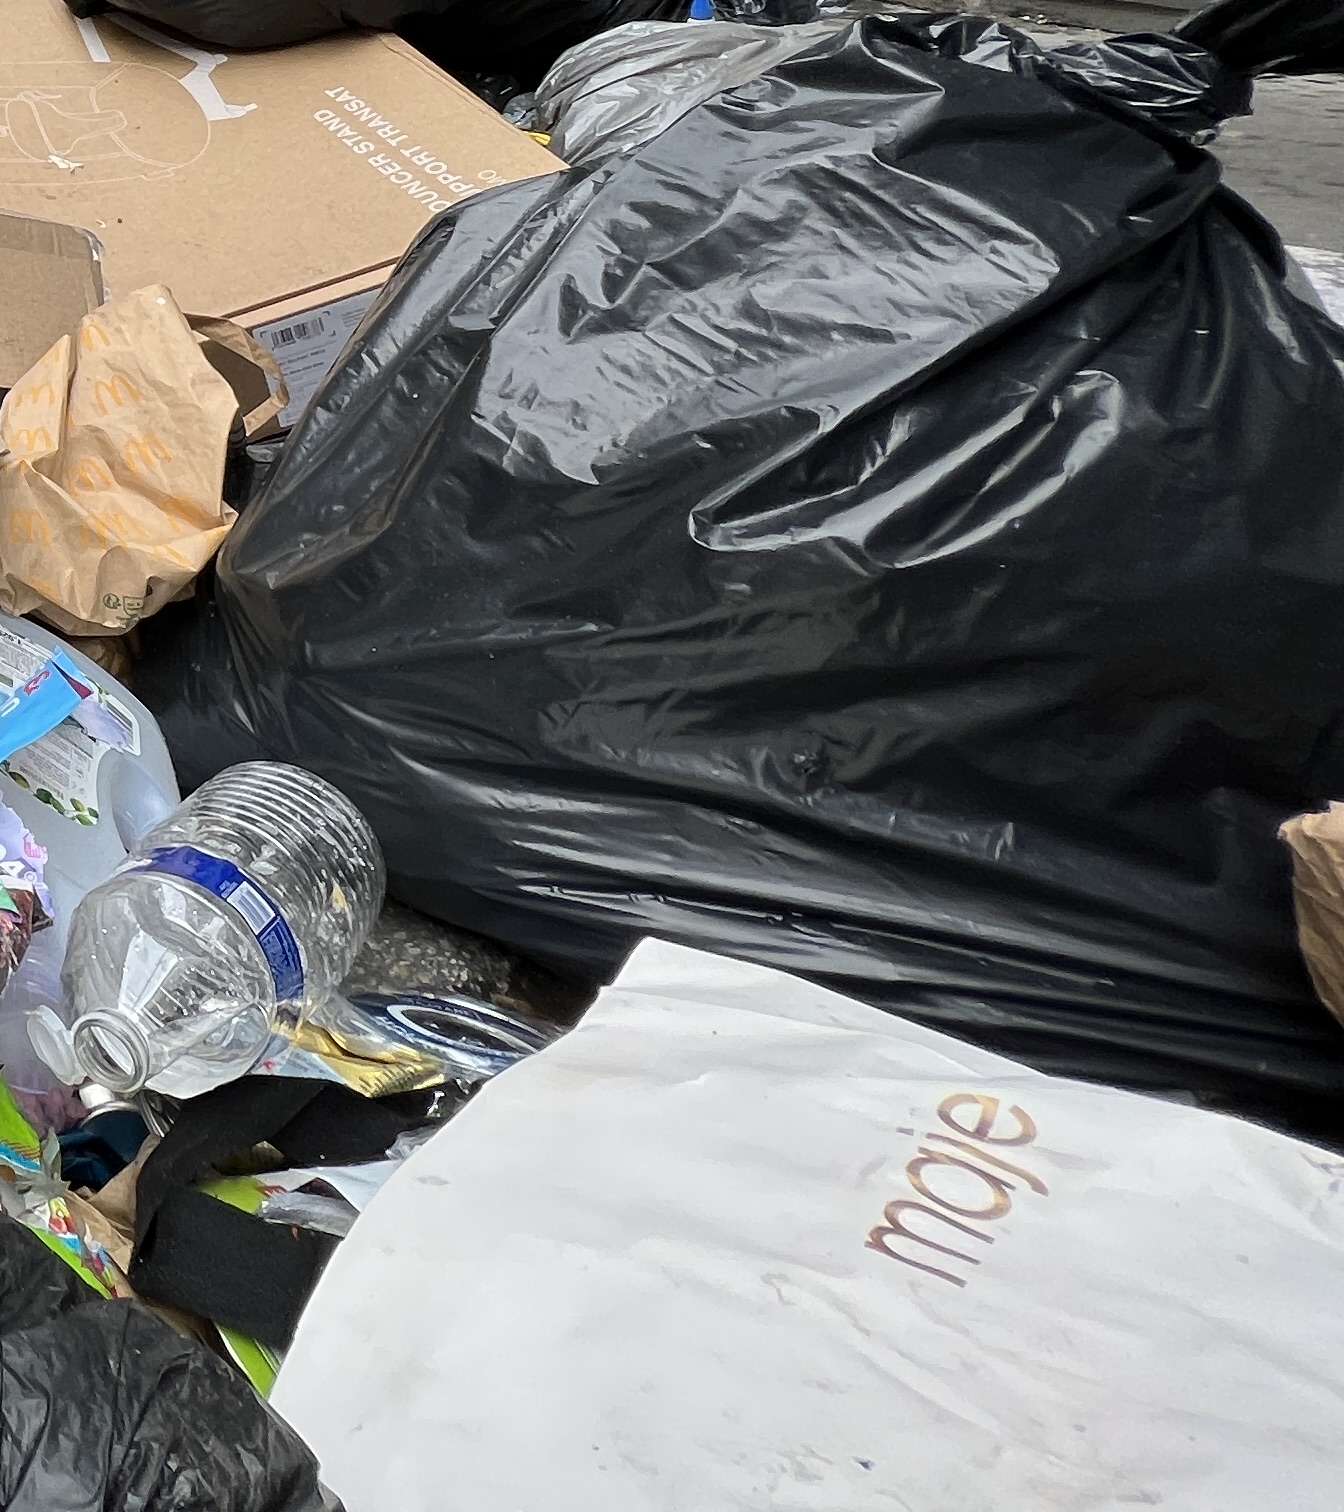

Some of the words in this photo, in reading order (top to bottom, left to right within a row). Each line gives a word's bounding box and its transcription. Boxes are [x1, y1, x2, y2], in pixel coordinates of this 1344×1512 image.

[313, 109, 375, 155] STAND
[324, 86, 408, 147] TRANSAT
[367, 152, 453, 212] OUNCER
[863, 1092, 1049, 1288] maje
